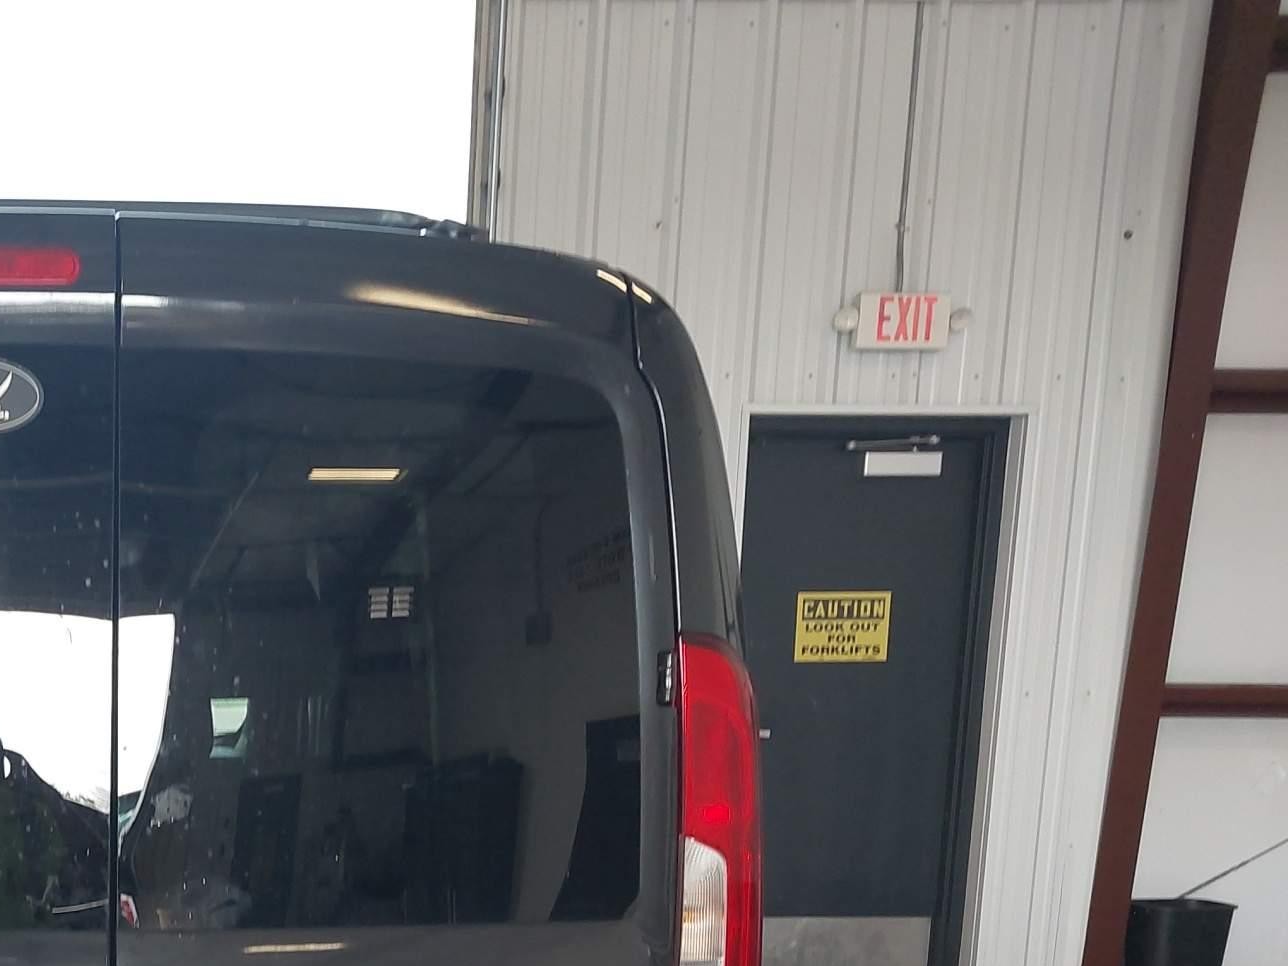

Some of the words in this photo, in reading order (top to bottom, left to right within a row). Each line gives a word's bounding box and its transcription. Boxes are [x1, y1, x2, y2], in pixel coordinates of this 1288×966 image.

[876, 295, 938, 342] EXIT
[803, 600, 885, 619] CAUTION
[805, 623, 844, 632] LOOK
[849, 623, 880, 632] OUT
[827, 634, 856, 643] FOR
[801, 645, 881, 656] FORKLIFTS
